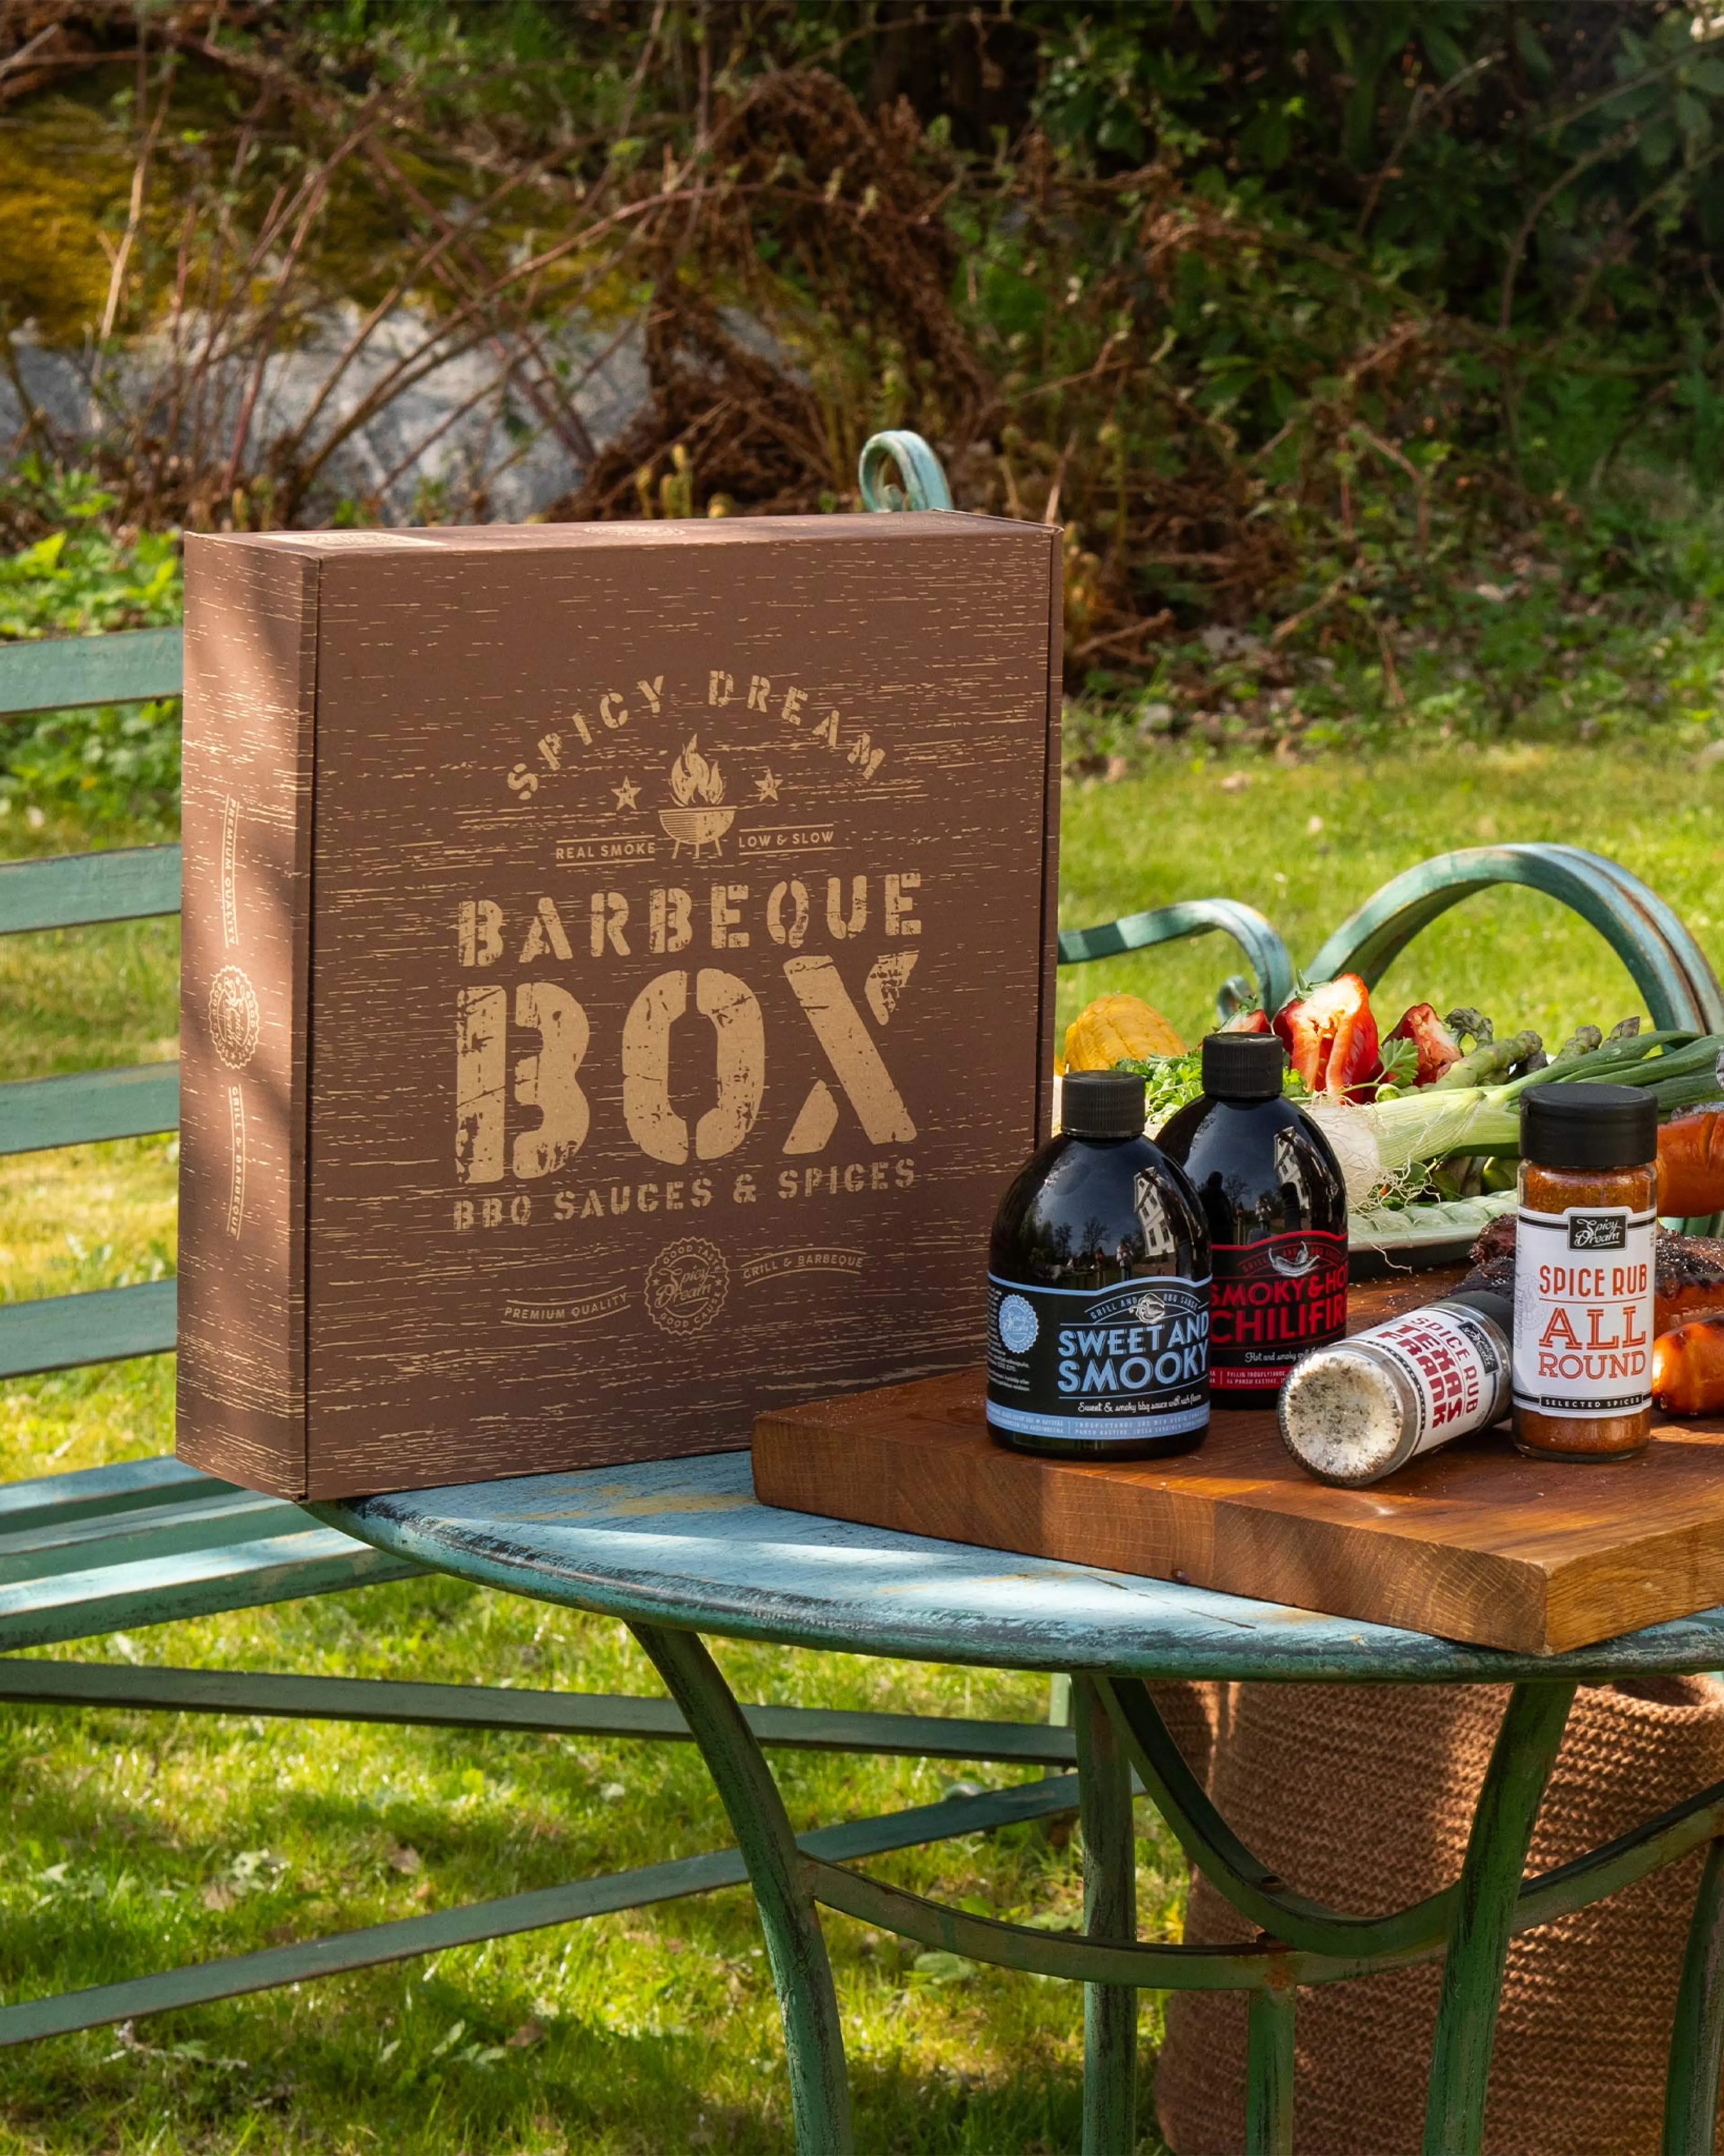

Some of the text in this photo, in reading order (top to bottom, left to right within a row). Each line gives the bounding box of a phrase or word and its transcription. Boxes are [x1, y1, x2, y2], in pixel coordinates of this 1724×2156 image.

[507, 670, 886, 800] SPICY DREAM
[225, 798, 236, 870] PREMIUM
[556, 842, 655, 859] REAL SMOKE
[739, 831, 834, 848] LOW & SLOW
[458, 873, 921, 967] BARBEQUE
[455, 950, 919, 1184] BOX
[453, 1158, 916, 1230] BBQ SAUCES & SPICES
[1574, 1230, 1620, 1248] Dream
[1576, 1217, 1622, 1238] Spicy
[743, 1254, 864, 1279] GRILL & BARBEQUE
[1539, 1263, 1647, 1297] SPICE RUB
[505, 1292, 627, 1320] PREMIUM QUALITY
[1210, 1294, 1346, 1343] CHILIFIR
[1538, 1305, 1646, 1350] ALL
[1058, 1324, 1165, 1357] SWEET
[1167, 1311, 1209, 1348] AND
[1058, 1339, 1209, 1392] SMOOKY
[1396, 1324, 1463, 1424] TEXAS
[1410, 1317, 1469, 1362] SPICE
[1464, 1364, 1480, 1415] RUB
[1538, 1350, 1646, 1380] ROUND
[1078, 1402, 1103, 1413] Sweet
[1114, 1401, 1137, 1413] smoky
[1545, 1397, 1640, 1408] SELECTED SPICES
